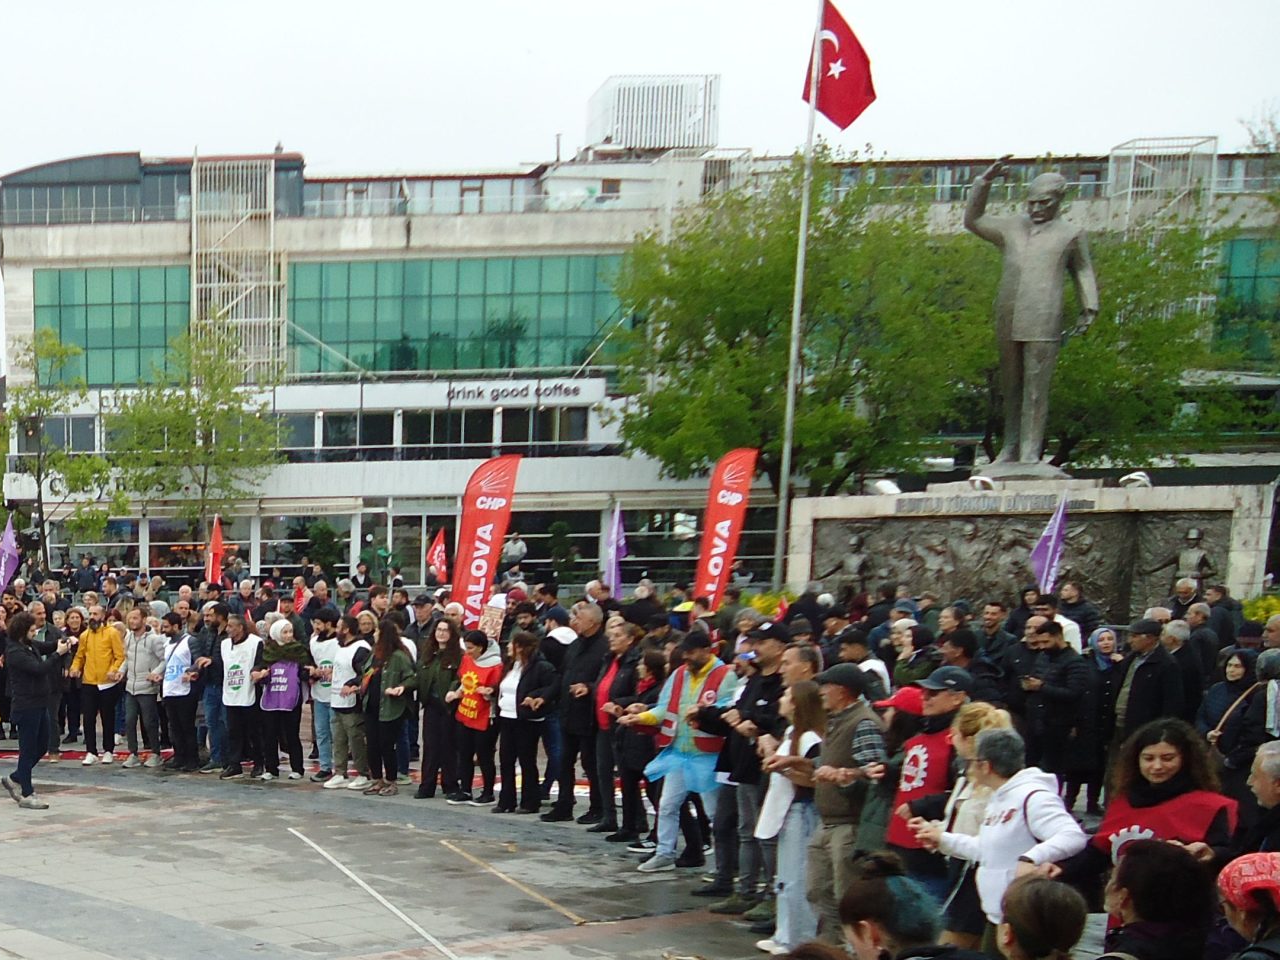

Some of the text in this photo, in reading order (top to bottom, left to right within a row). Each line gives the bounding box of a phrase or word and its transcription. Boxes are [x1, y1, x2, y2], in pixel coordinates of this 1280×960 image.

[447, 384, 581, 401] drink good coffee
[476, 496, 507, 510] CHP
[464, 523, 494, 626] YALOVA
[705, 520, 732, 609] ALOVA
